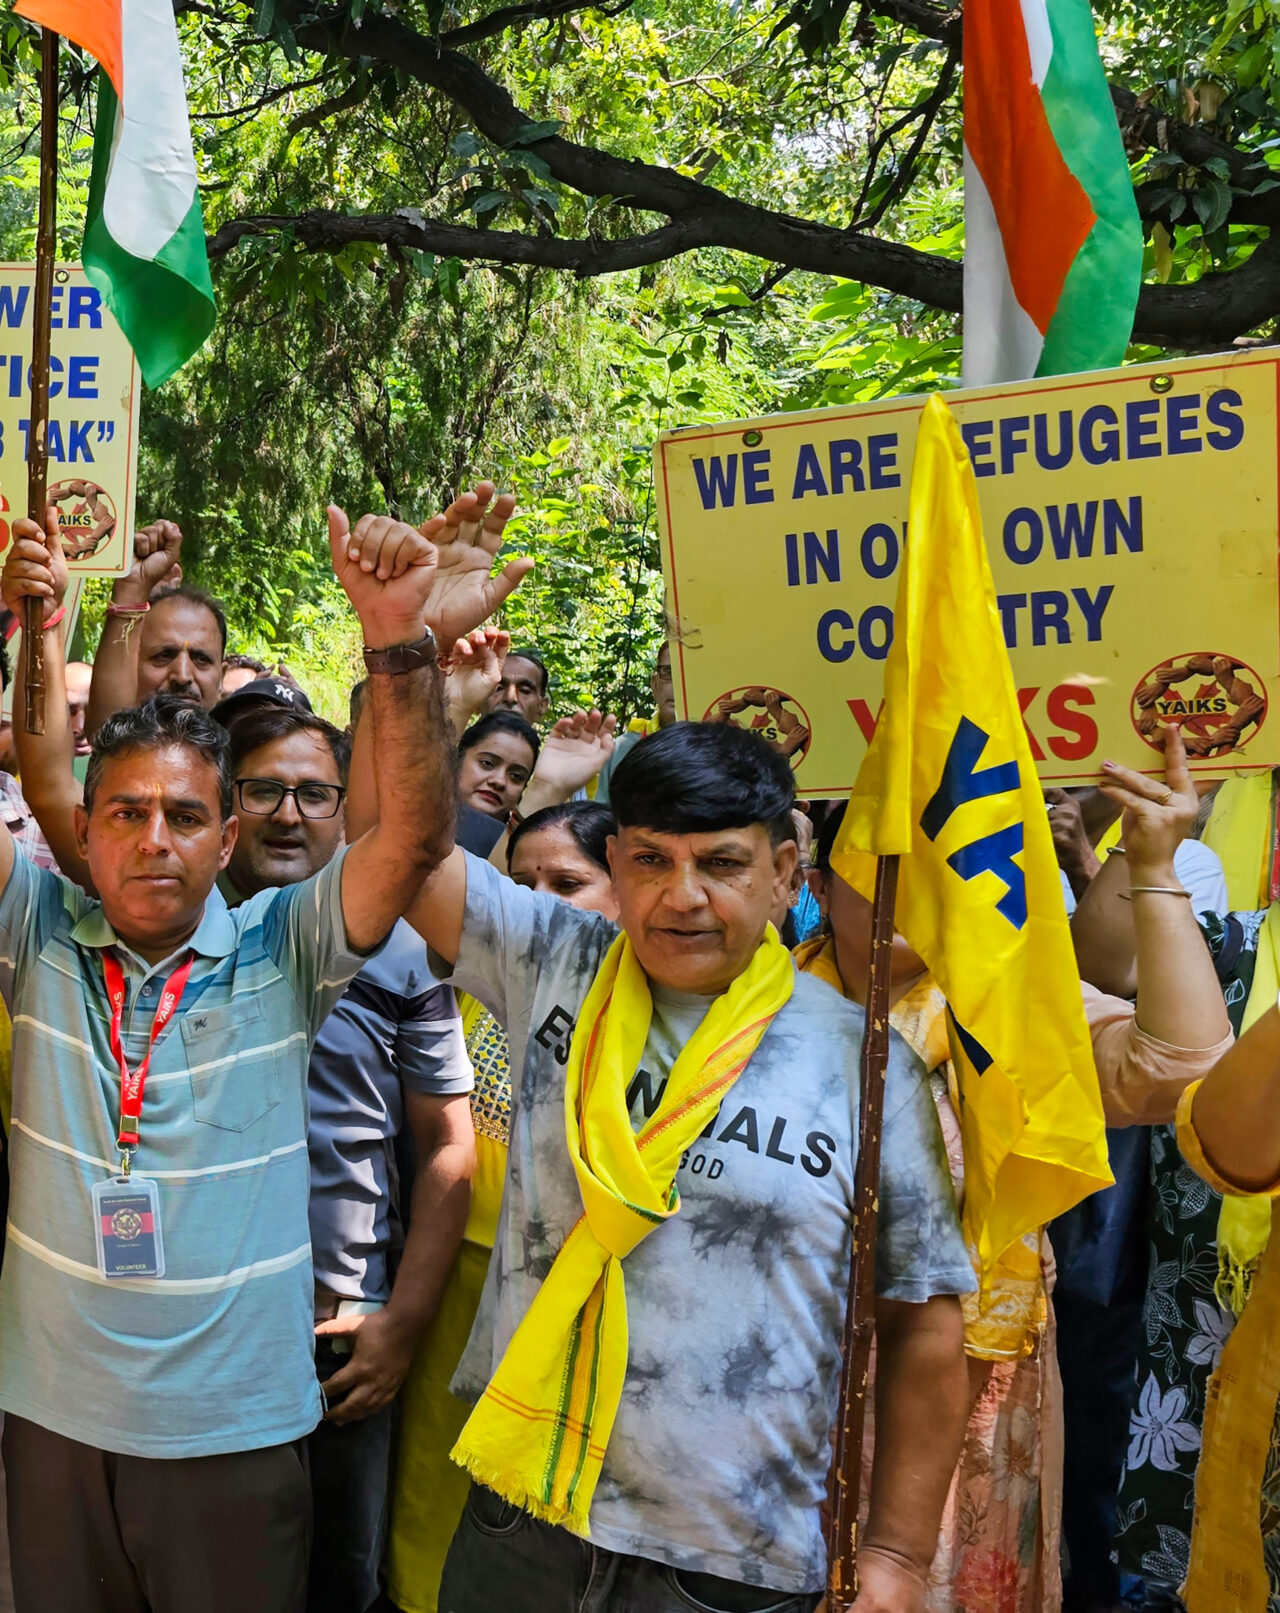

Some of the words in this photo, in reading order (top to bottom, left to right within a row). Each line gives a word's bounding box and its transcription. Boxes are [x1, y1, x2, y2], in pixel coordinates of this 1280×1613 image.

[692, 449, 775, 511] WE
[792, 432, 903, 500] ARE
[961, 389, 1245, 478] EFUGEES
[58, 514, 91, 526] AIKS
[785, 529, 841, 586] IN
[1003, 495, 1144, 566] OWN
[817, 585, 1114, 663] COTRY
[1158, 698, 1227, 715] YAIKS
[157, 991, 176, 1024] YAIKS
